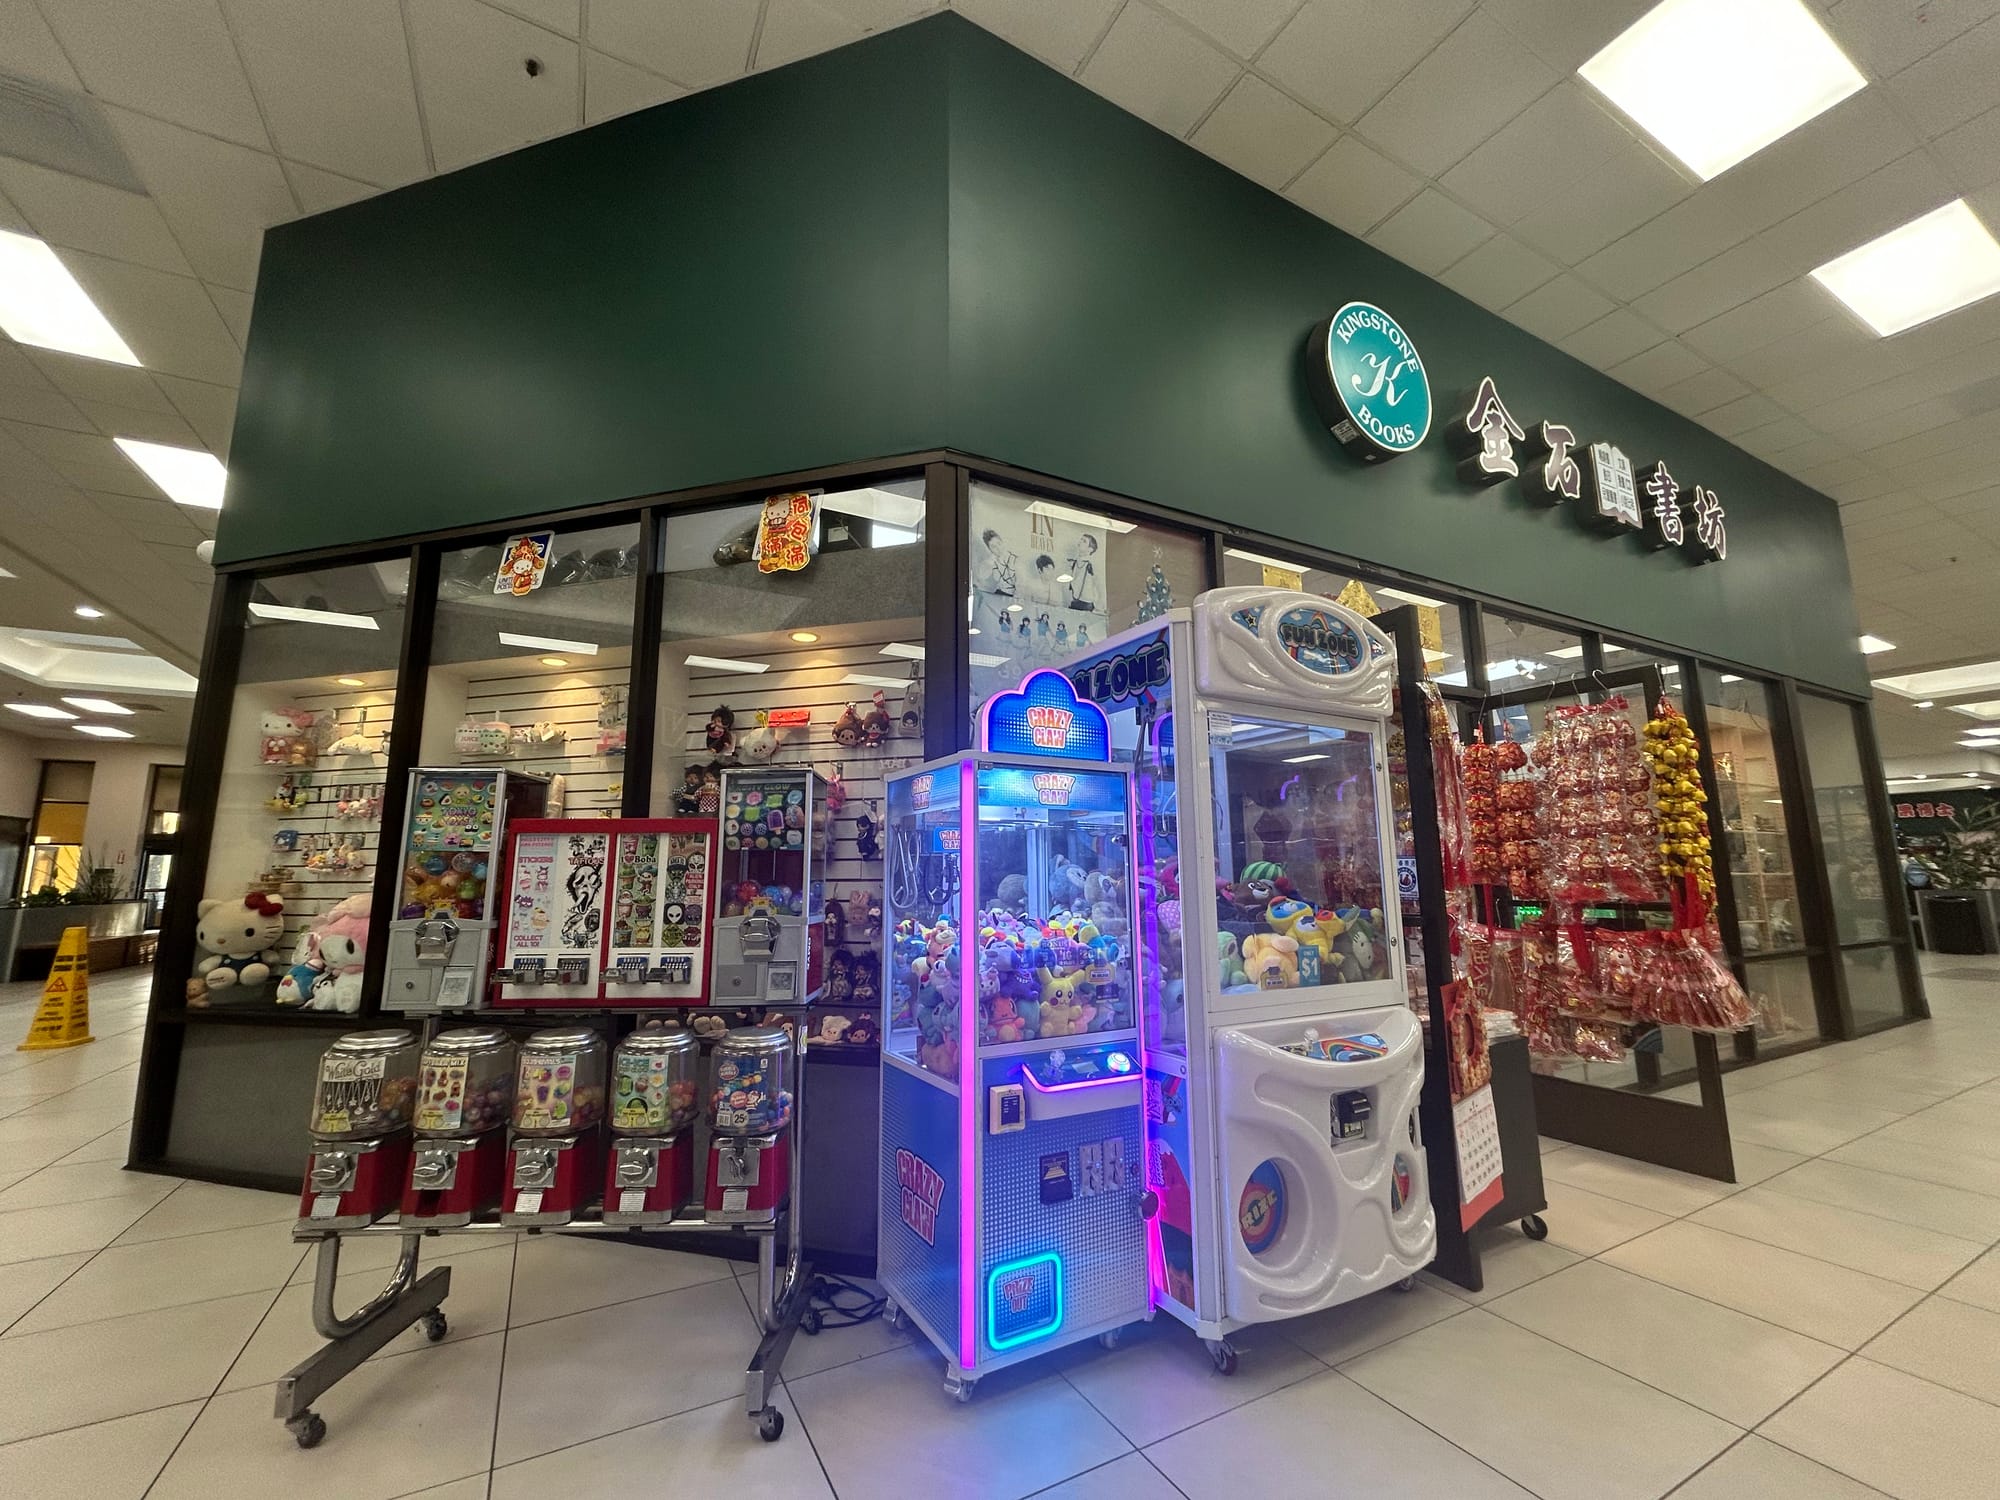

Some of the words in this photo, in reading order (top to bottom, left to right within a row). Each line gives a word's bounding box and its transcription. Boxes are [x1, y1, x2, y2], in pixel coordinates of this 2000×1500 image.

[1336, 310, 1419, 373] KINGSTONE
[1351, 352, 1408, 407] K
[1357, 404, 1415, 444] BOOKS
[1280, 623, 1316, 648] FUN
[1317, 629, 1360, 657] ZONE
[1026, 706, 1073, 731] CRAZY
[1033, 727, 1067, 748] CLAW
[1032, 773, 1075, 792] CRAZY
[1038, 788, 1069, 806] CLAW
[441, 807, 477, 817] TOKYO
[568, 857, 605, 865] TATTOOS
[634, 855, 656, 863] Boba
[1302, 958, 1318, 978] $1
[353, 1060, 381, 1077] Gold
[896, 1148, 945, 1215] CRAZY
[1011, 1295, 1028, 1314] OUT
